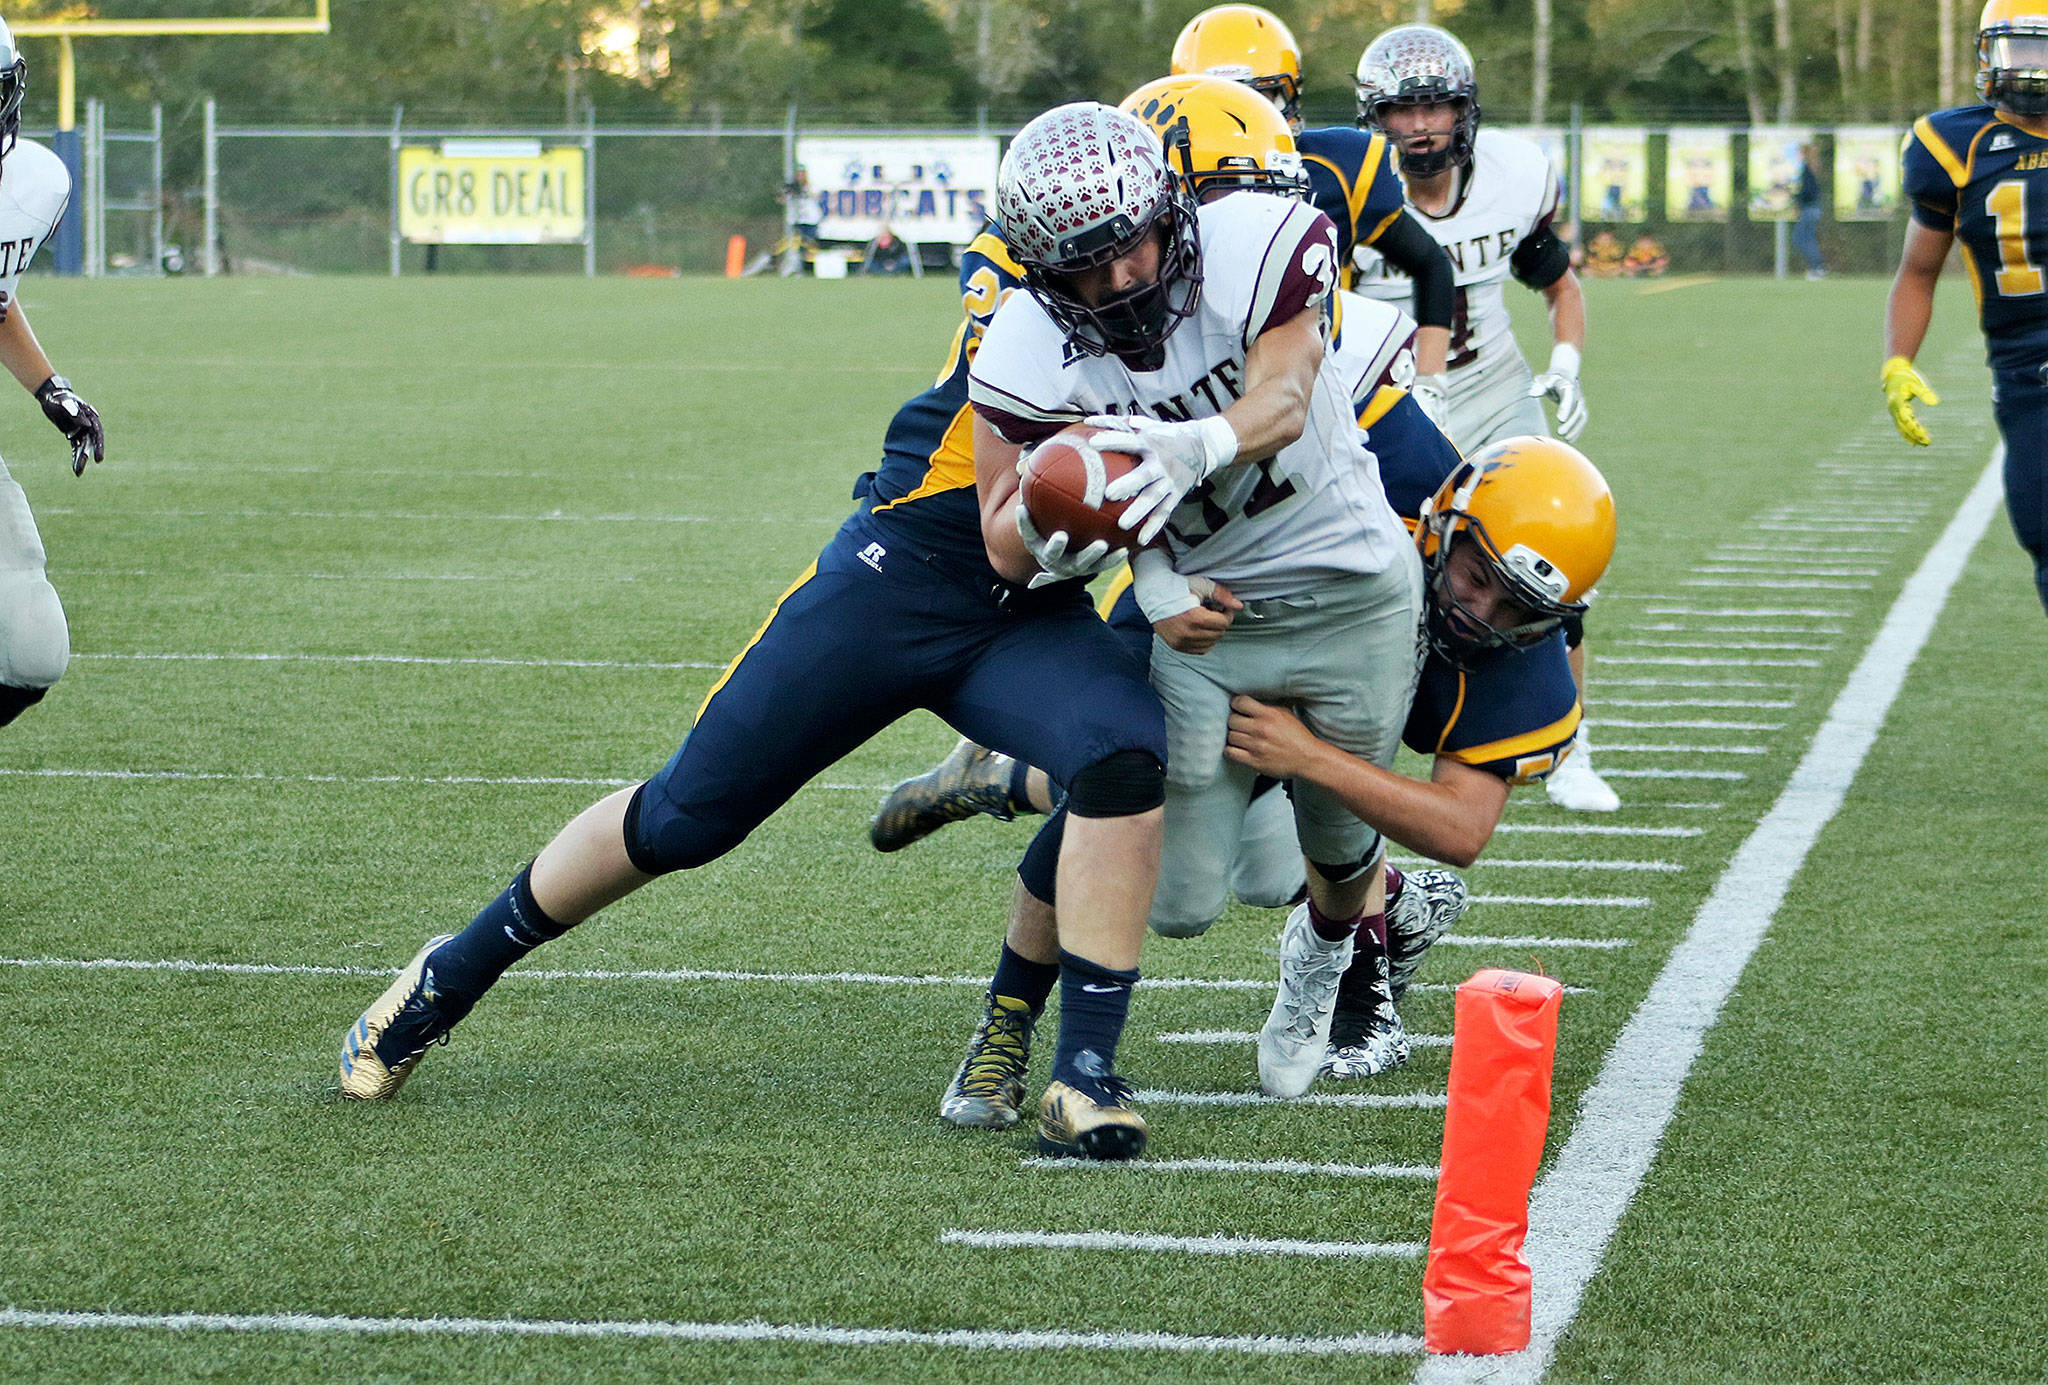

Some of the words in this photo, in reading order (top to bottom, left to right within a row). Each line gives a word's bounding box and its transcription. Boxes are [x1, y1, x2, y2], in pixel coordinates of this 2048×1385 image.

[410, 168, 477, 217] GR8
[491, 168, 574, 217] DEAL
[1985, 179, 2046, 298] 1
